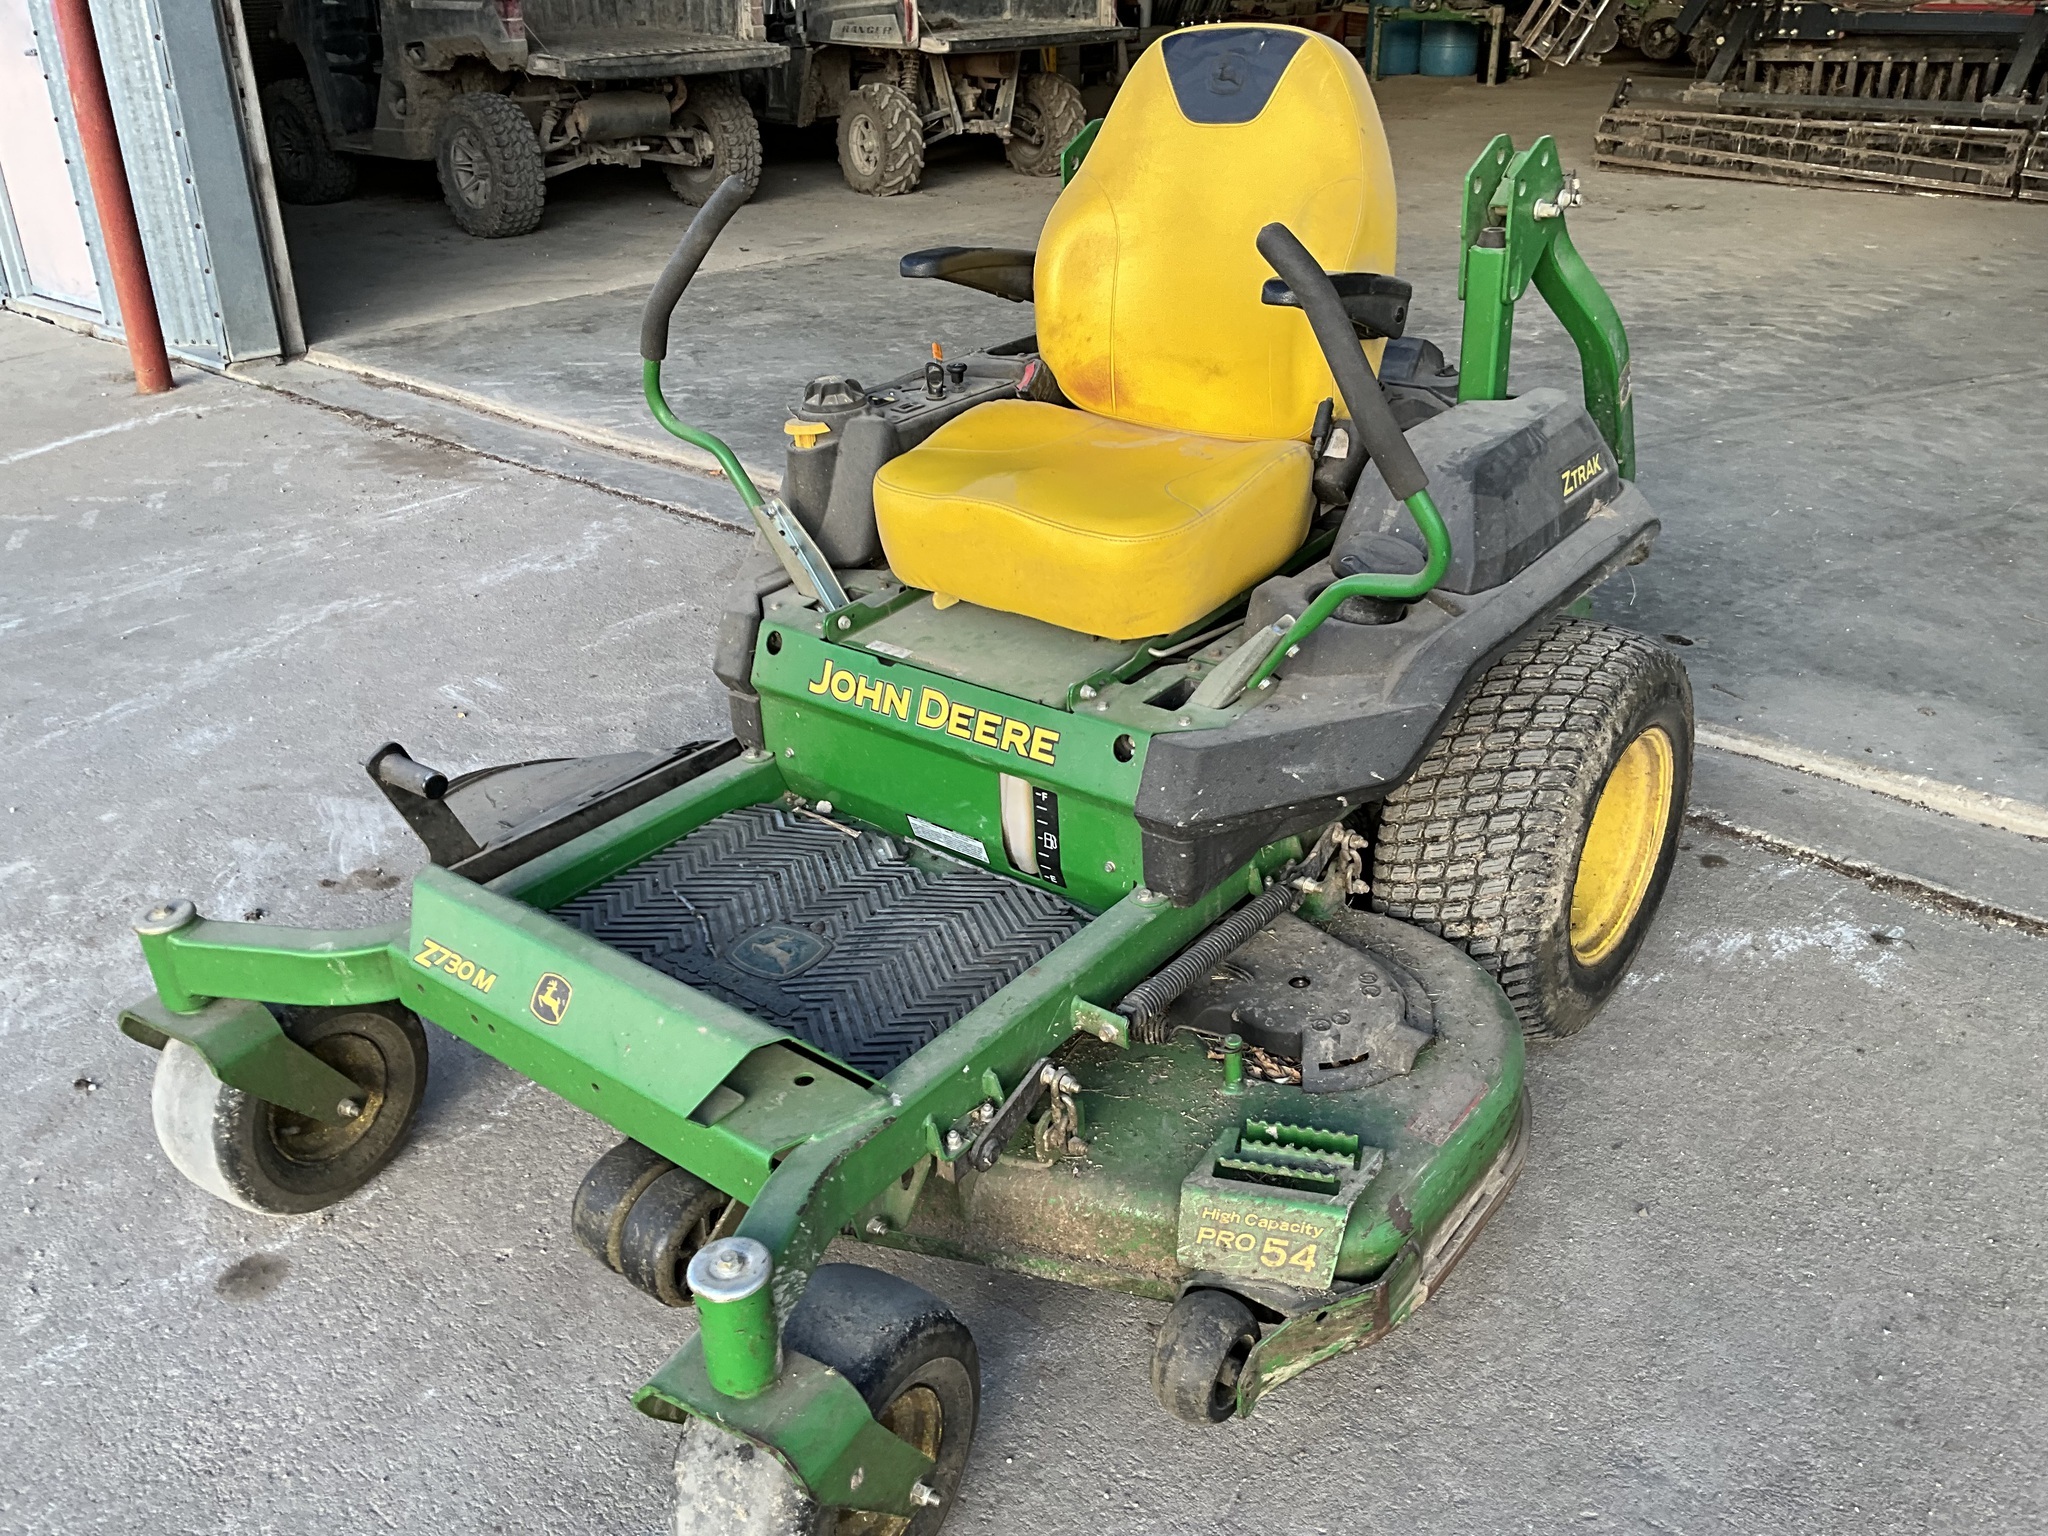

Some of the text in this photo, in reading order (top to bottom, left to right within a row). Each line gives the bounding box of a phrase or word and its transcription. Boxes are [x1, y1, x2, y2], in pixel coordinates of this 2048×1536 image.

[841, 25, 892, 35] RANGER
[1561, 452, 1602, 497] ZTRAK
[808, 658, 1061, 767] JOHN DEERE
[1041, 791, 1048, 801] F
[1201, 1206, 1325, 1239] High Capacity
[1195, 1226, 1318, 1274] PRO 54
